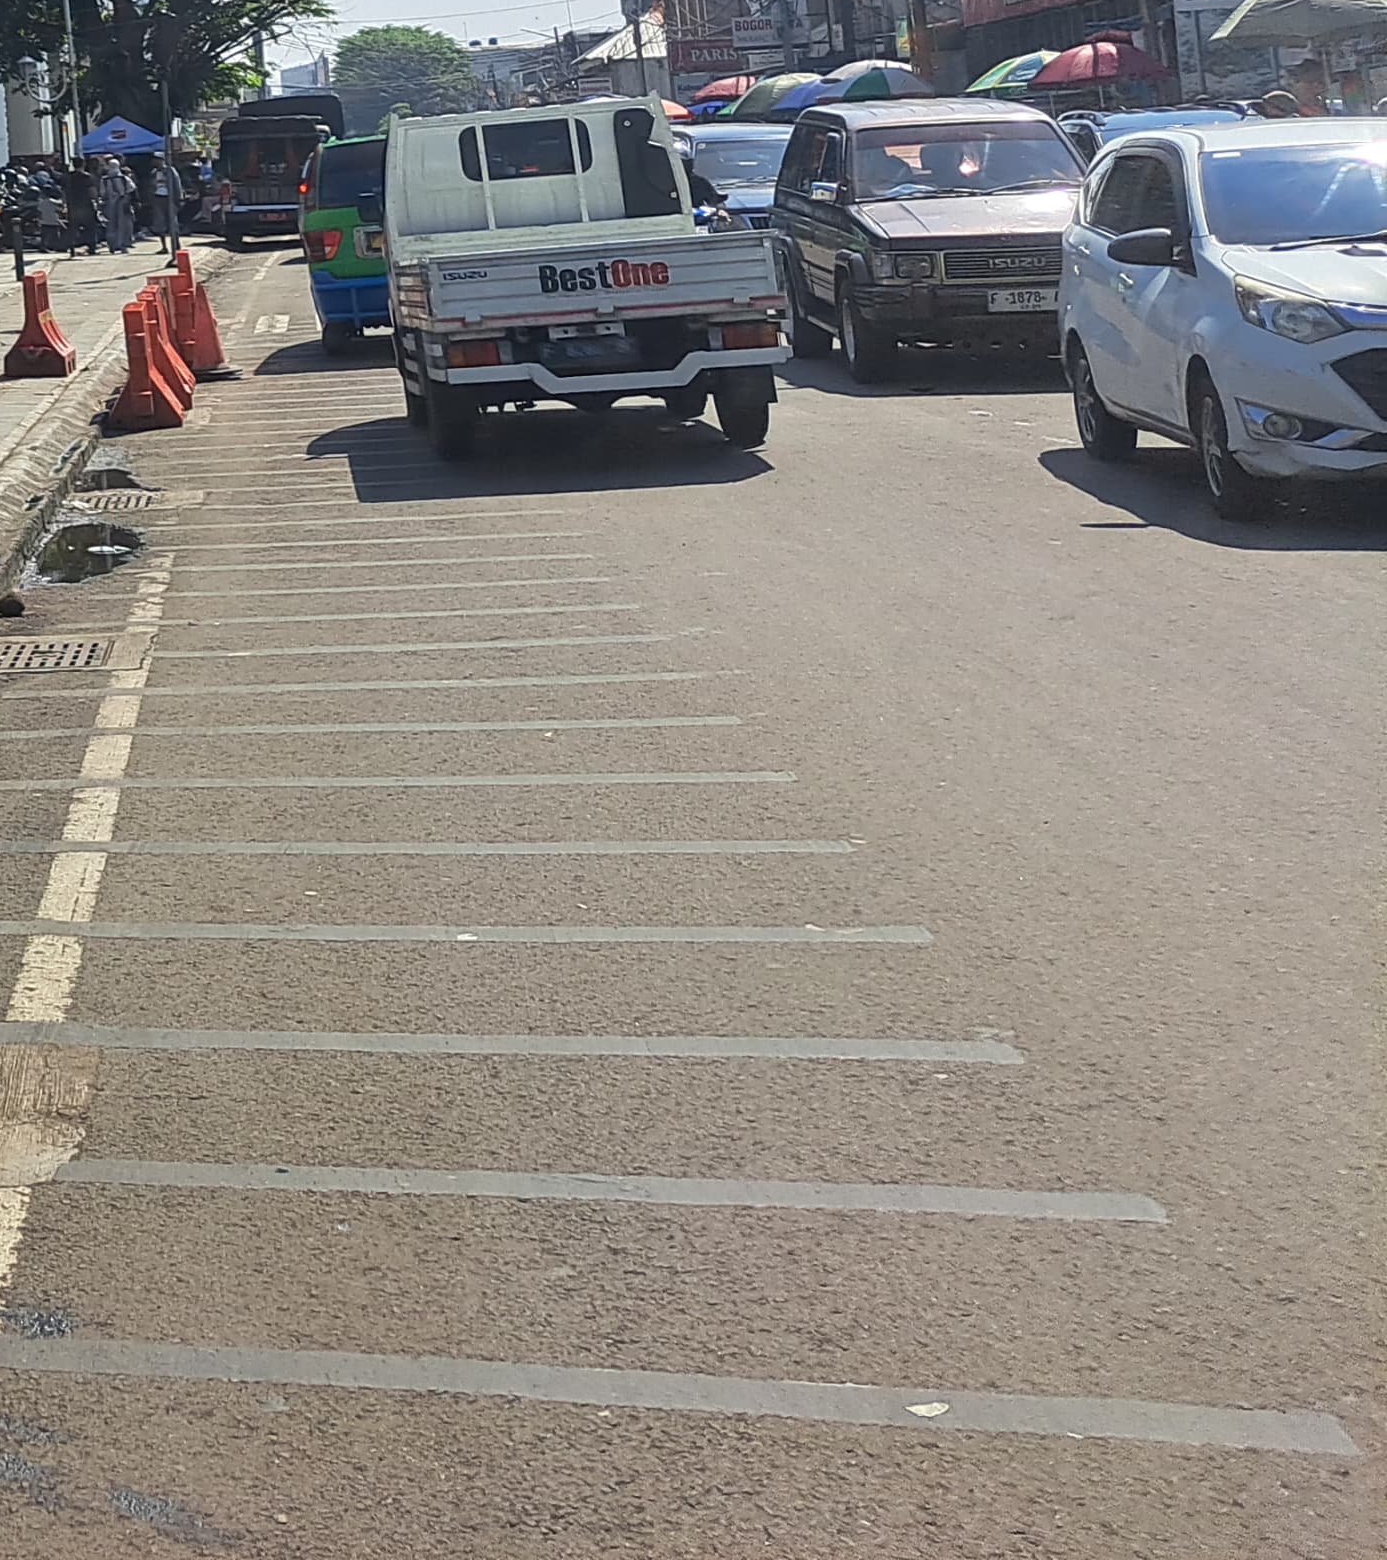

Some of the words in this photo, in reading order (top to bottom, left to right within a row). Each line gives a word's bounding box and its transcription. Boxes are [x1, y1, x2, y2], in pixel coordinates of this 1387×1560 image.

[734, 18, 772, 32] BOGOR
[691, 47, 738, 62] PARIS
[988, 256, 1046, 269] ISUZU
[443, 270, 488, 282] ISUZU
[538, 259, 670, 294] BestOne
